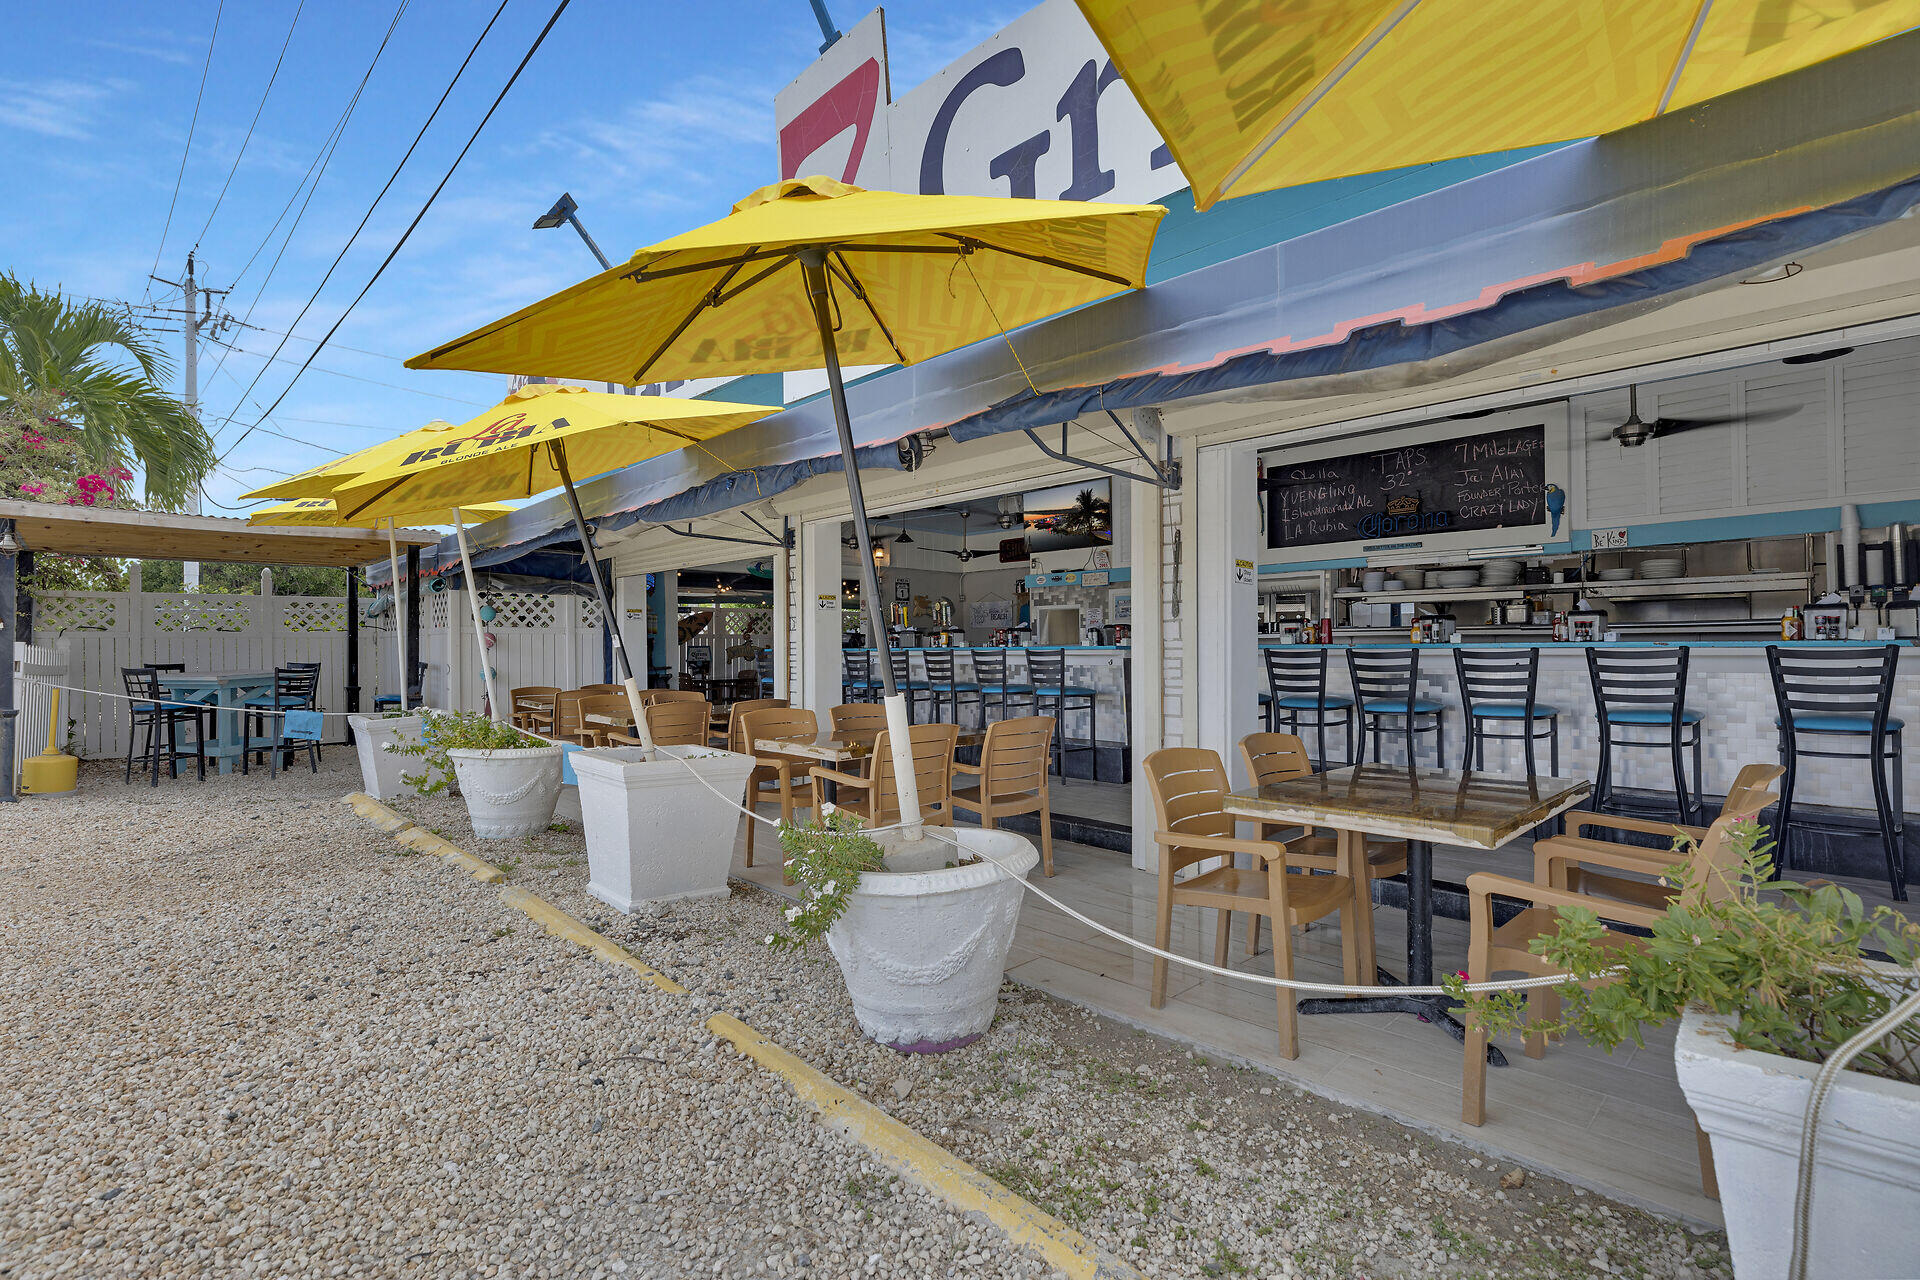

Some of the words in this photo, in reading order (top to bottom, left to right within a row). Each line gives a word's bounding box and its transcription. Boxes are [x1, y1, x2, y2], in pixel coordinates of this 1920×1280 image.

[780, 56, 880, 184] 7
[447, 412, 529, 444] La
[399, 417, 571, 467] RUBIA
[440, 449, 489, 465] BLONDE
[494, 442, 520, 453] ALE
[1454, 442, 1468, 463] 7
[1473, 439, 1506, 461] Mile
[1356, 494, 1374, 509] Ale
[1459, 503, 1504, 519] CRAZY
[1509, 498, 1538, 521] LADY
[1309, 519, 1349, 535] Rubia
[1357, 511, 1448, 539] Corona
